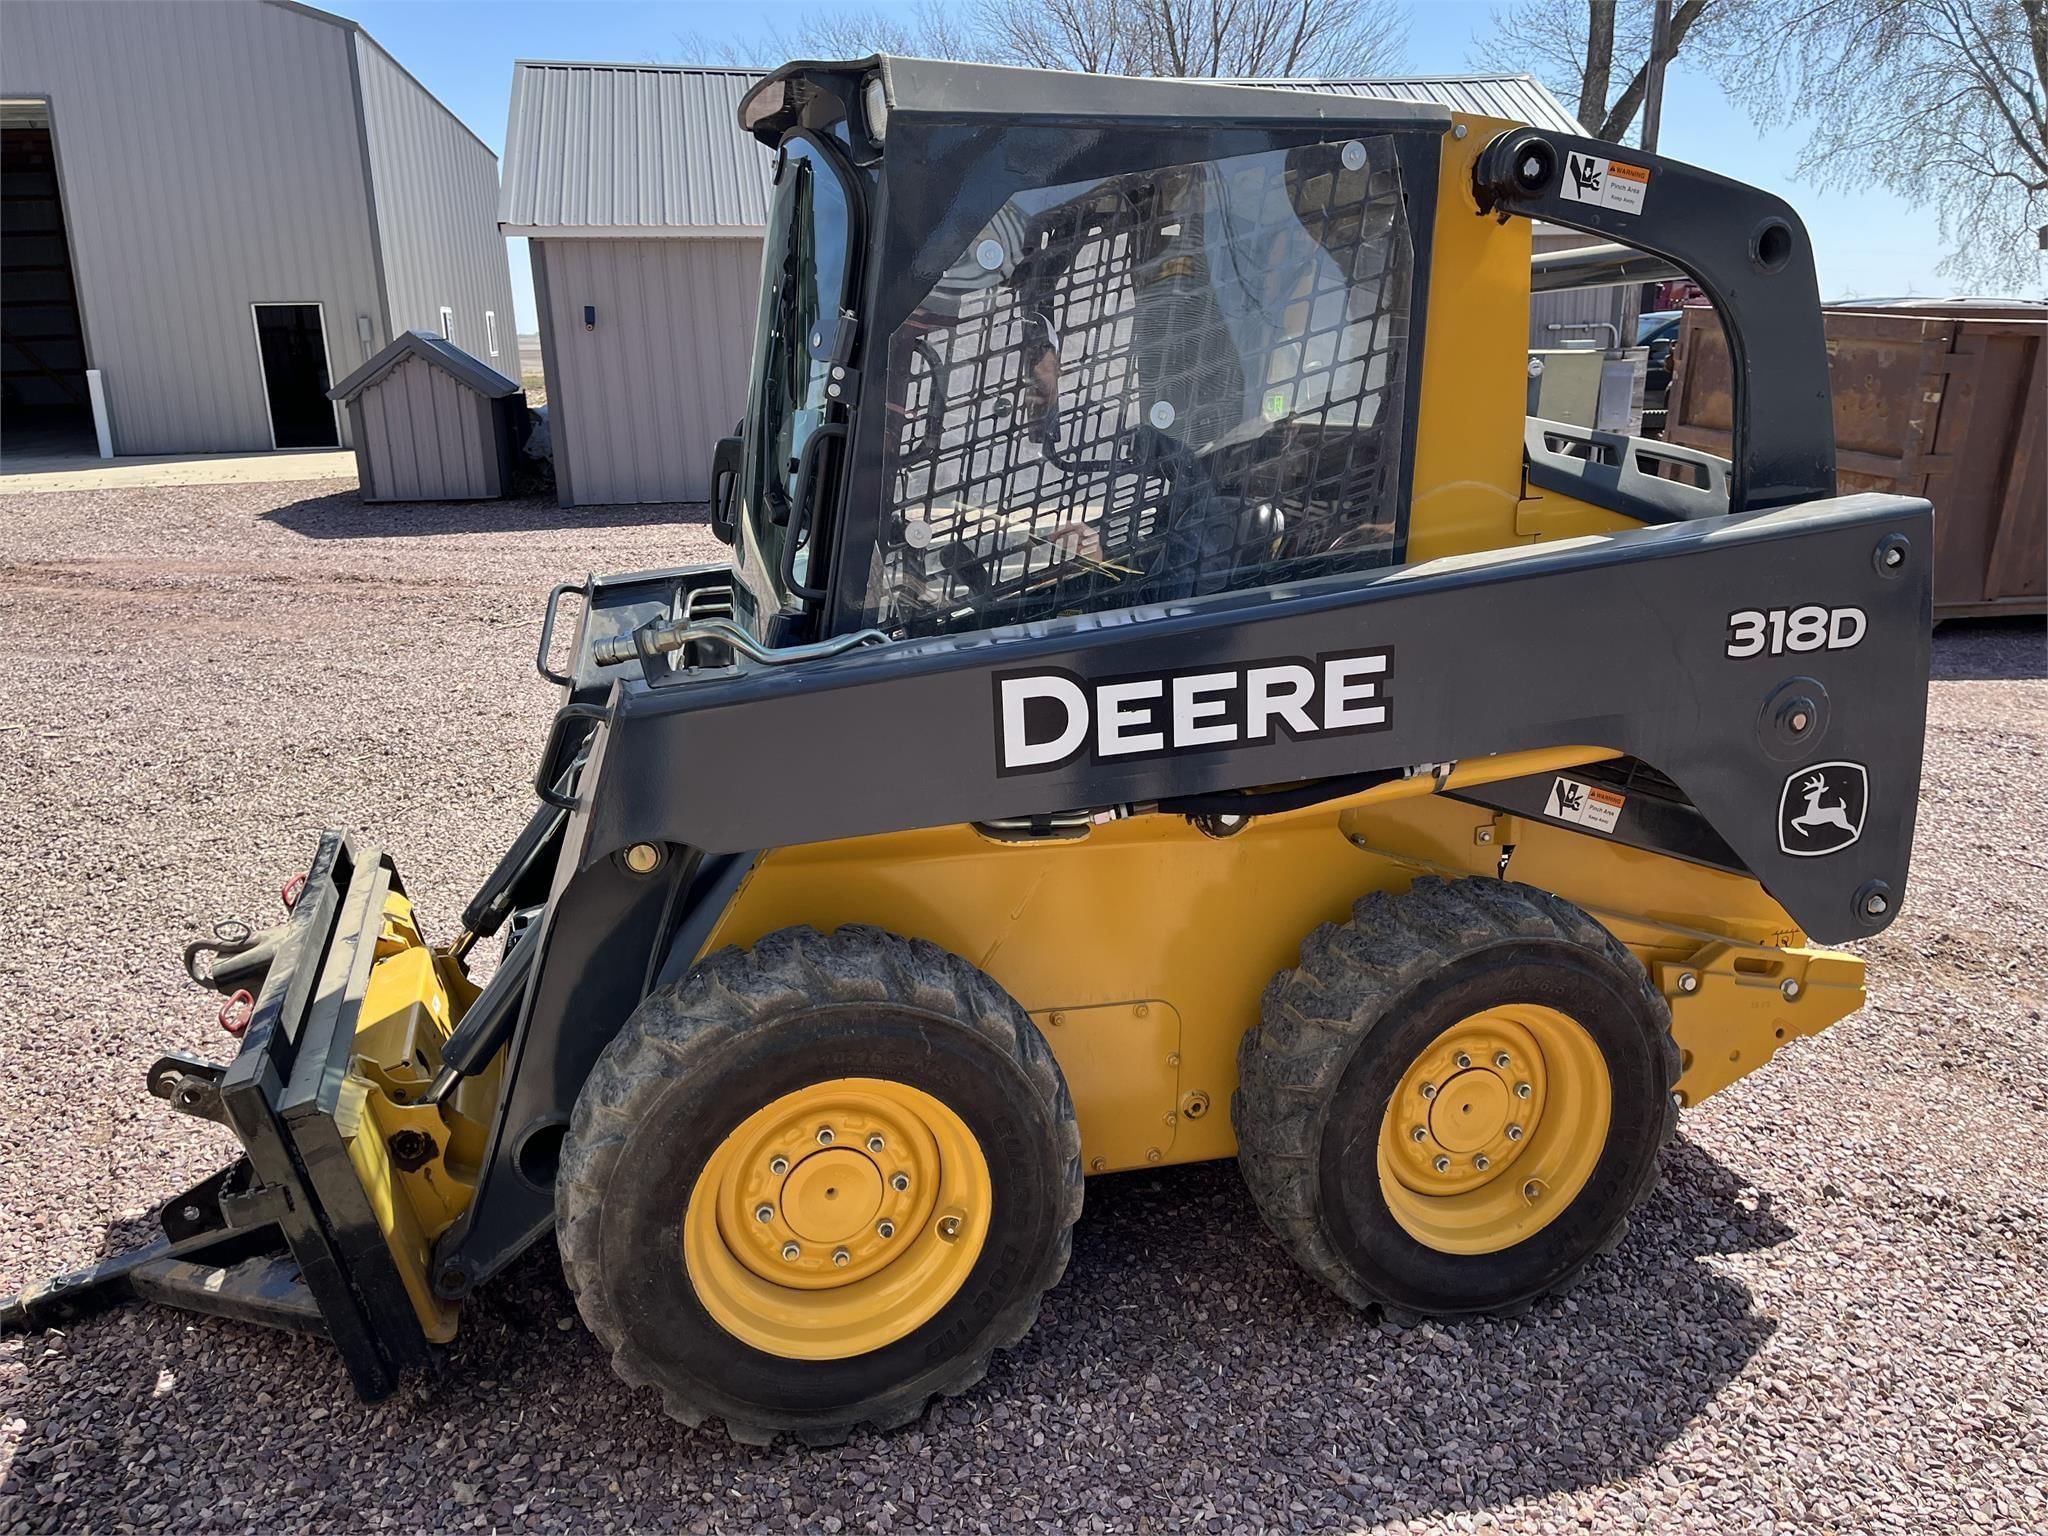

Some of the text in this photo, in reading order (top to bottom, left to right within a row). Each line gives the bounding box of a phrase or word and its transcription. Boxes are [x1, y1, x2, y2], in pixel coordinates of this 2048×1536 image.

[1616, 167, 1646, 179] WARNING
[1610, 182, 1640, 194] Pinch Area
[1727, 606, 1867, 657] 318D
[1001, 655, 1387, 768] DEERE
[1597, 792, 1622, 805] WARNING
[1589, 804, 1615, 816] Pinch Area
